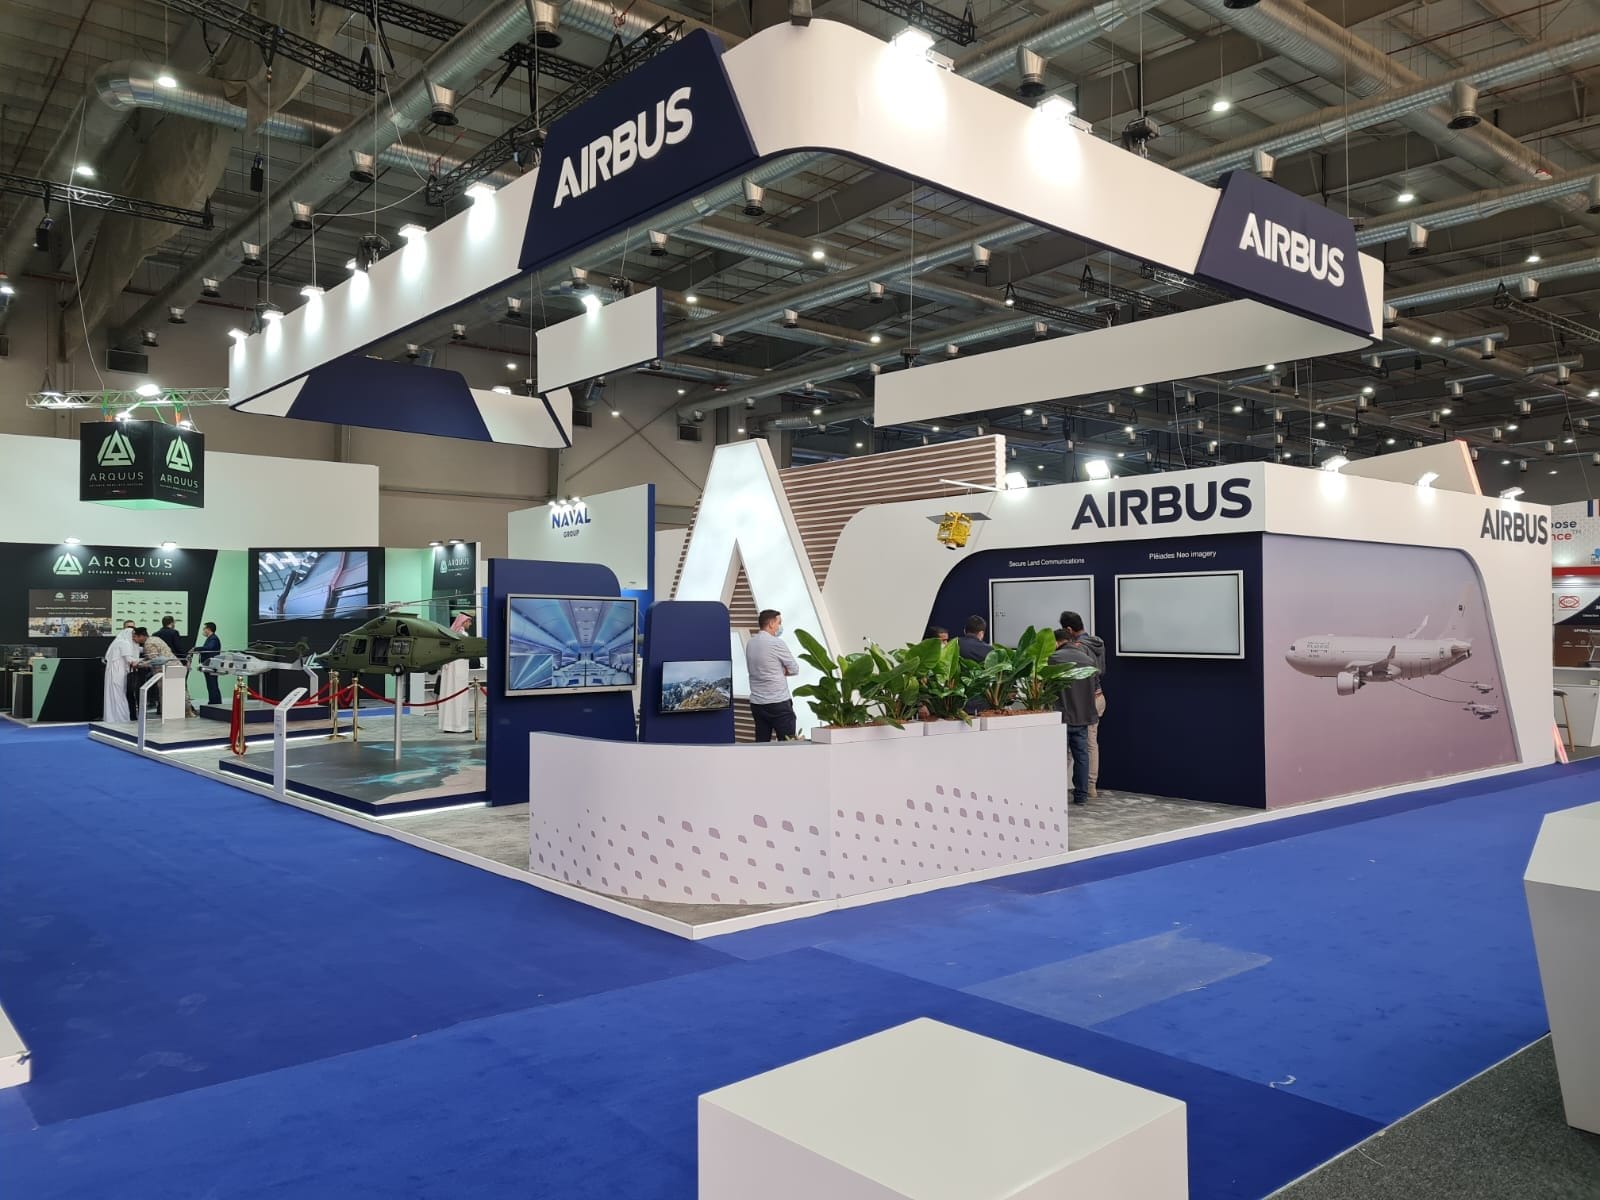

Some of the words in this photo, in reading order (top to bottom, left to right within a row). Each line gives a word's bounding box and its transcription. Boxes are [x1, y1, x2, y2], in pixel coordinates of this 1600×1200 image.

[553, 86, 693, 209] AIRBUS
[1239, 212, 1345, 287] AIRBUS
[89, 471, 144, 482] ARQUUS
[160, 473, 199, 489] ARQUUS
[1071, 477, 1253, 530] AIRBUS
[552, 507, 592, 529] NAVAL
[1480, 508, 1548, 545] AIRBUS
[88, 555, 173, 569] ARQUUS
[1008, 560, 1027, 568] Secure
[1027, 559, 1040, 567] Land
[1040, 557, 1085, 566] Communications
[1176, 551, 1190, 559] Neo
[1190, 550, 1217, 559] imagery
